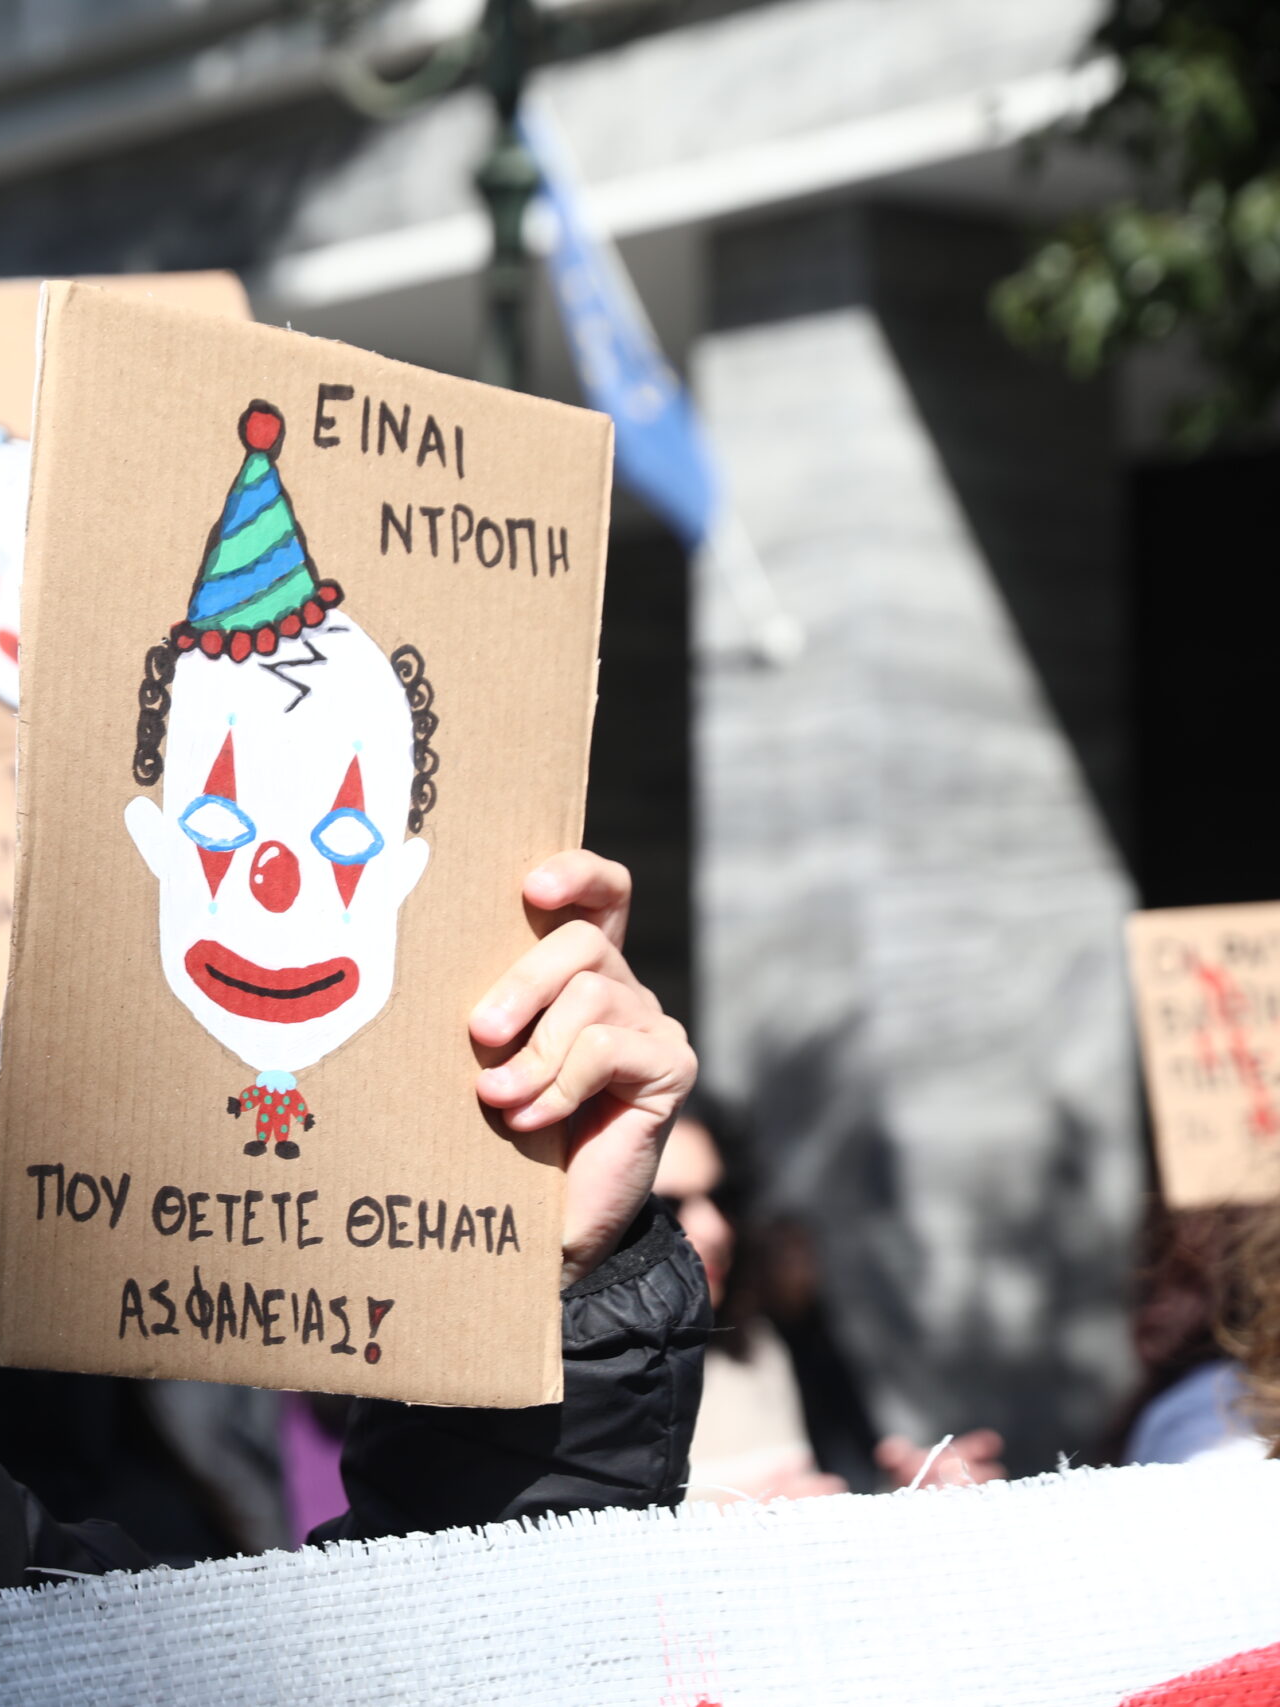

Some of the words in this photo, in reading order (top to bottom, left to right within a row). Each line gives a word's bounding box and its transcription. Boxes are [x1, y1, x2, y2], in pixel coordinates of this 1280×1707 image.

[313, 382, 464, 479] ΕΙΝΑΙ
[380, 501, 569, 577] ΝΤΡΟΠΗ
[26, 1163, 131, 1229] ΠΟΥ
[152, 1184, 324, 1250] ΘΕΤΕΤΕ
[346, 1195, 521, 1256] ΘΕΜΑΤΑ
[120, 1265, 395, 1364] ΑΣΦΑΛΕΙΑΣ!
